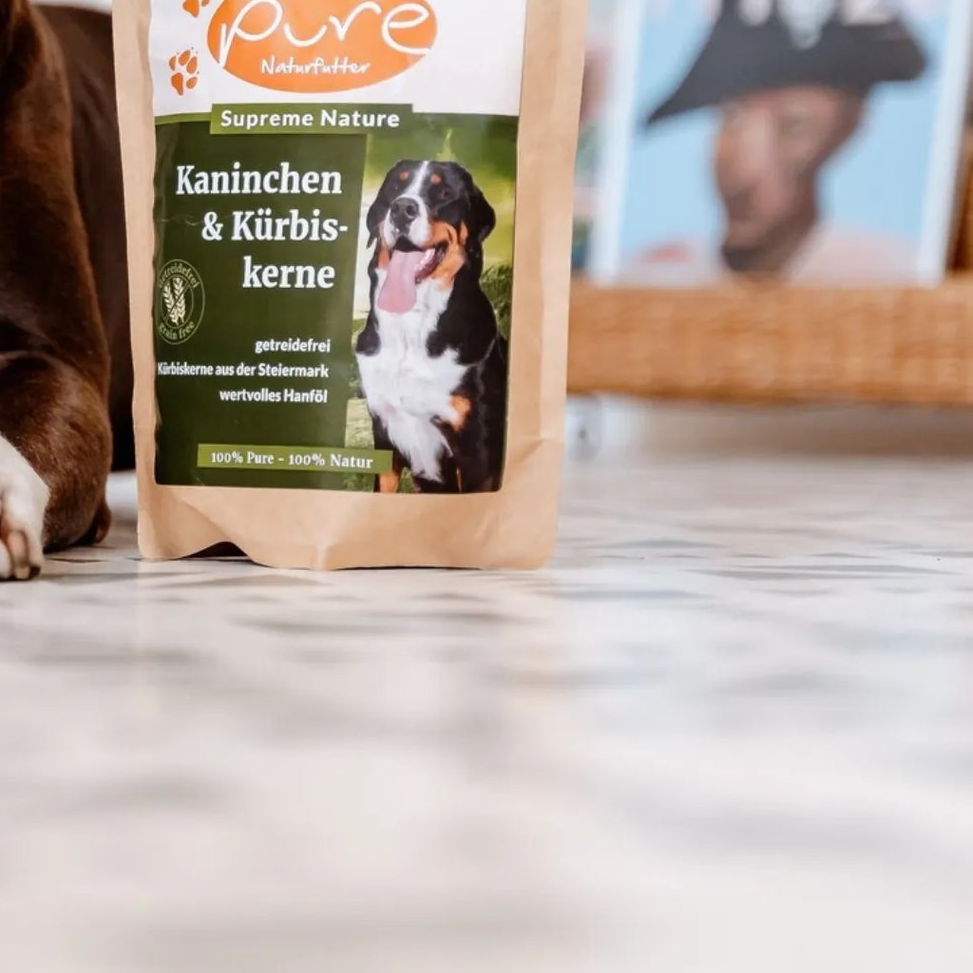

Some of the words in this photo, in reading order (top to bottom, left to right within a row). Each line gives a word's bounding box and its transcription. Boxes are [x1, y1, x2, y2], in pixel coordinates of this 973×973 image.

[261, 58, 371, 75] Naturfutter
[221, 110, 314, 129] Supreme
[320, 110, 400, 128] Nature
[176, 161, 343, 195] Kaninchen
[201, 211, 223, 241] &
[231, 208, 349, 241] Kürbis-
[242, 255, 336, 289] kerne
[255, 338, 331, 354] getreidefrei
[158, 362, 214, 376] Kürbiskerne
[215, 366, 235, 376] aus
[236, 362, 256, 376] der
[258, 363, 329, 378] Steiermark
[219, 388, 281, 402] wertvolles
[283, 388, 328, 404] Hanföl
[211, 452, 244, 463] 100%
[247, 451, 275, 464] Pure
[288, 453, 326, 466] 100%
[330, 454, 374, 469] Natur
